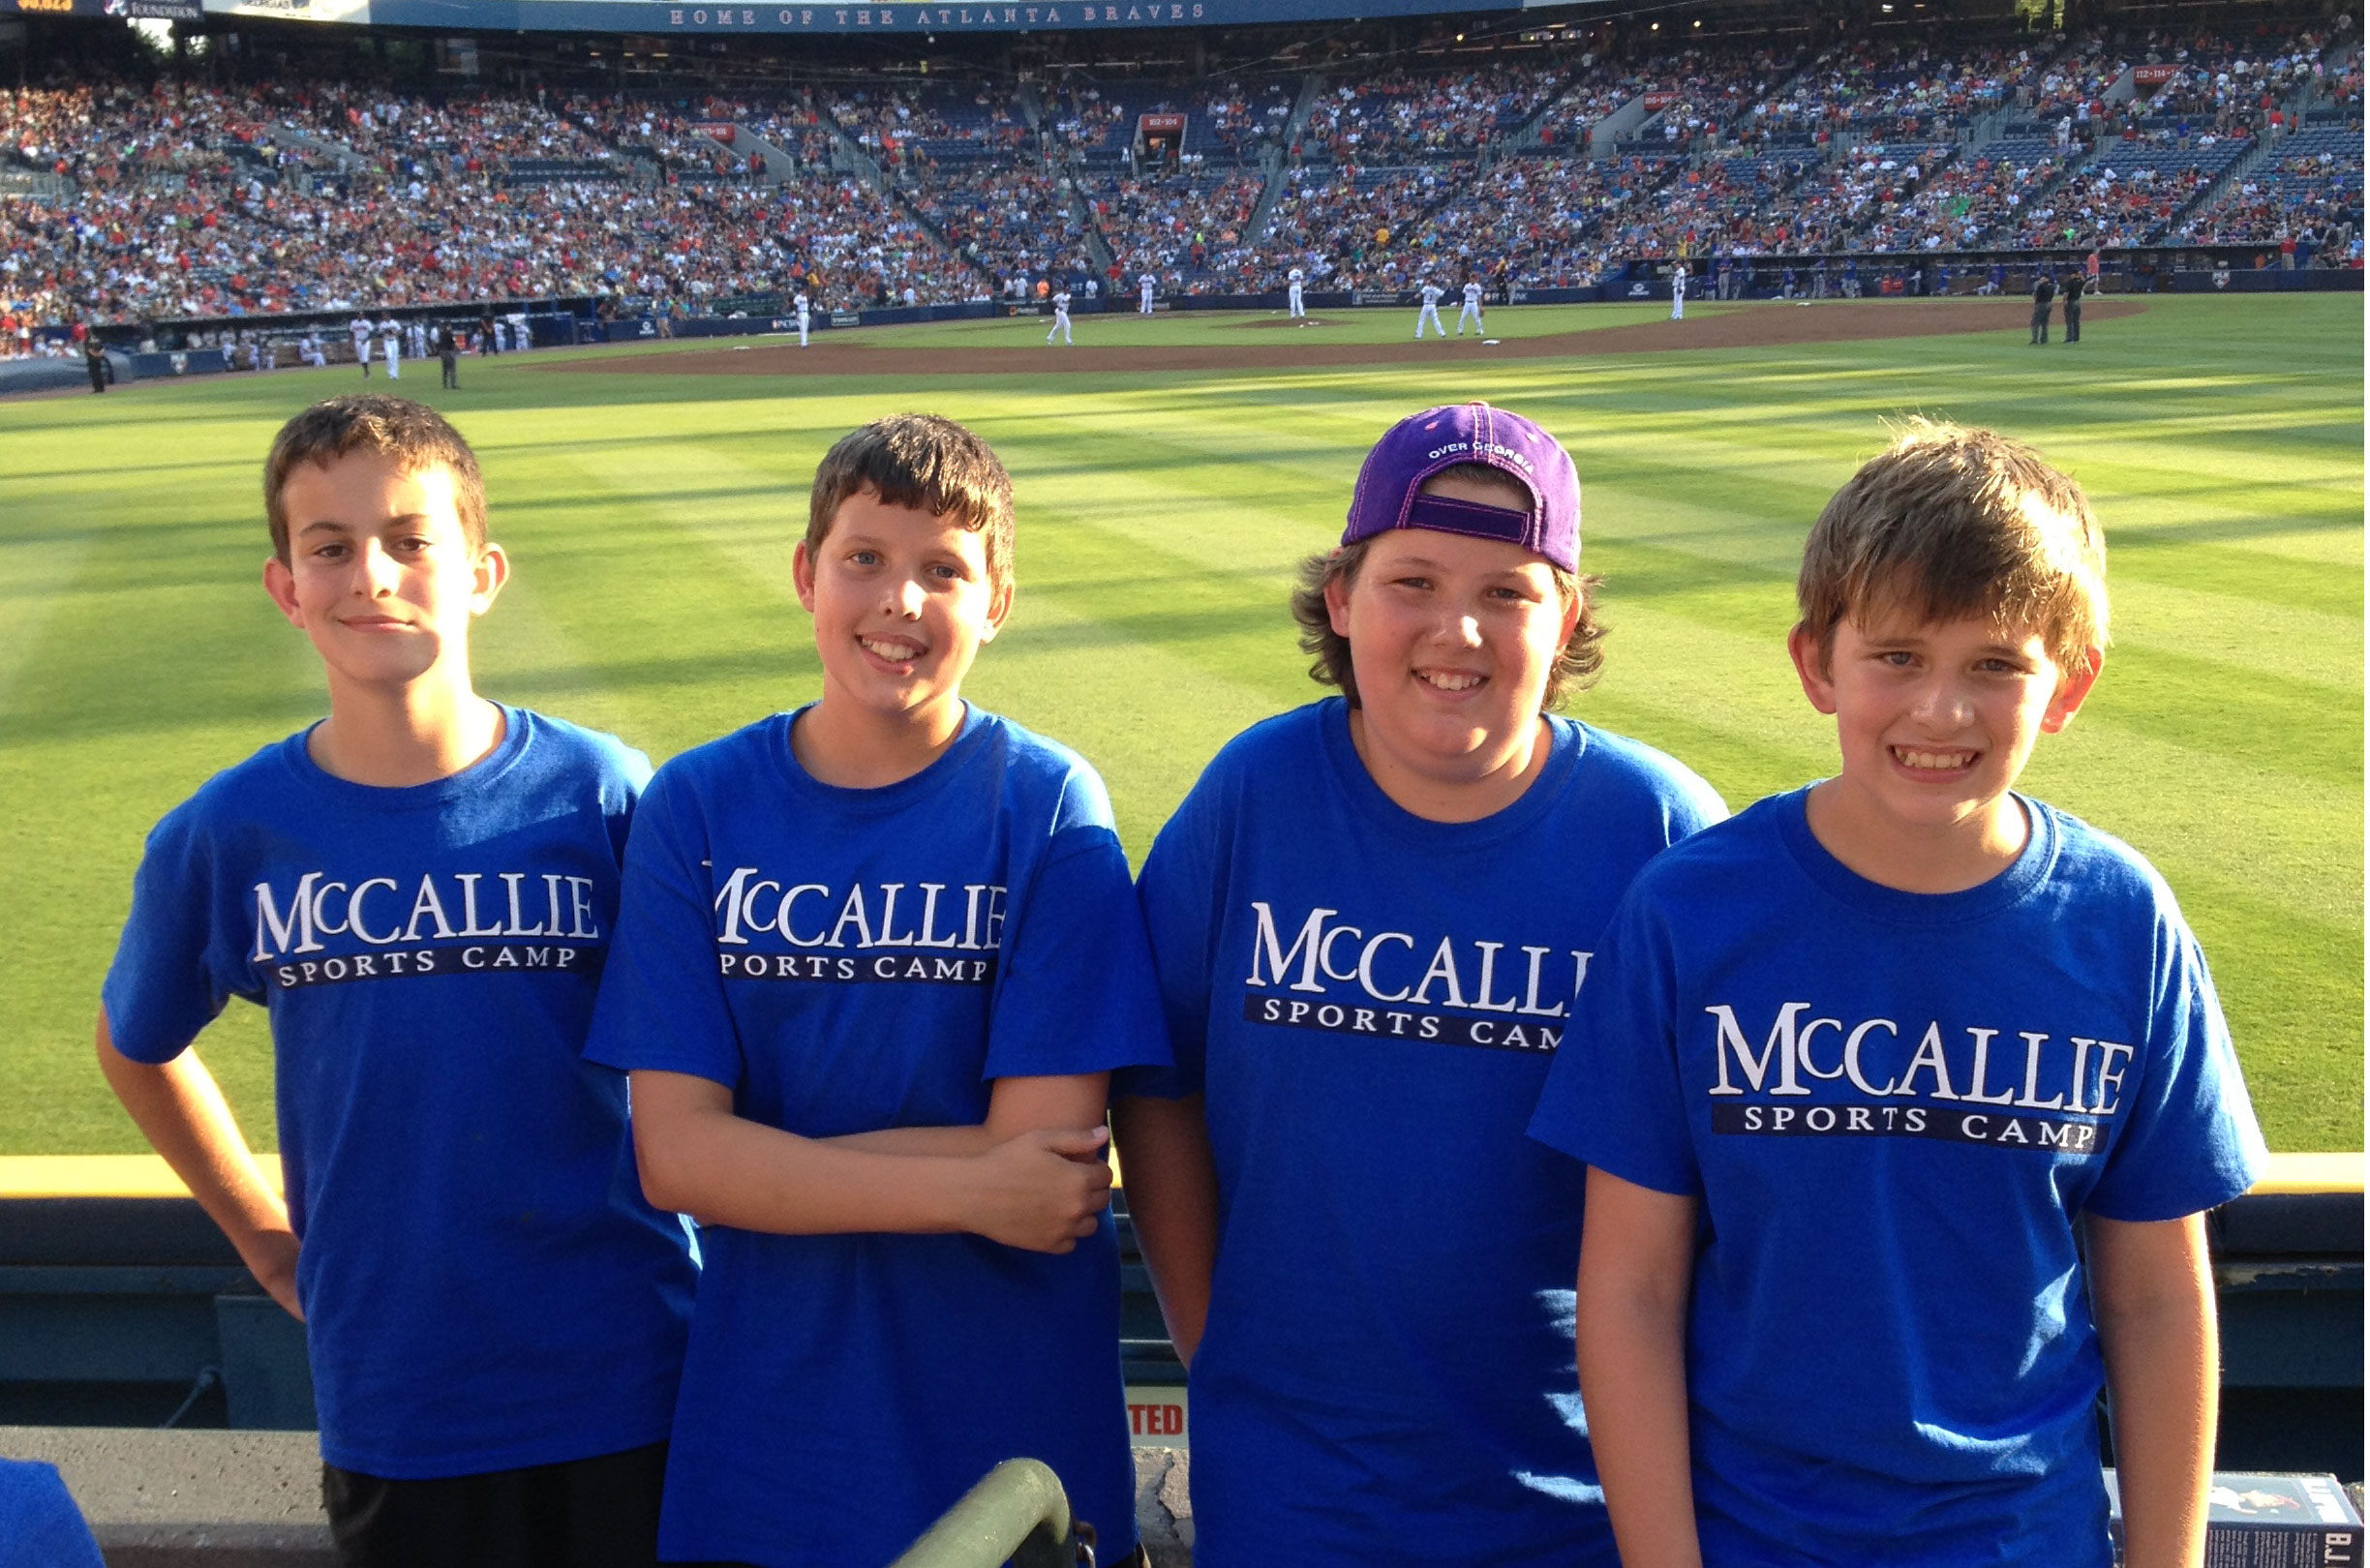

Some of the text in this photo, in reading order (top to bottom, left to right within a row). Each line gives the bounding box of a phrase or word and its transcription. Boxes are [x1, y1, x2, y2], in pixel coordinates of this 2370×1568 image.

[670, 4, 1203, 25] HOME OF THE ATLANTA BRAVES
[1429, 441, 1534, 475] OVER GEORGIA
[279, 947, 577, 987] SPORTS CAMP
[719, 953, 988, 981] PORTS CAMP
[1263, 999, 1564, 1049] SPORTS CAM
[1745, 1106, 2093, 1149] SPORTS CAMP
[1128, 1404, 1183, 1434] TED
